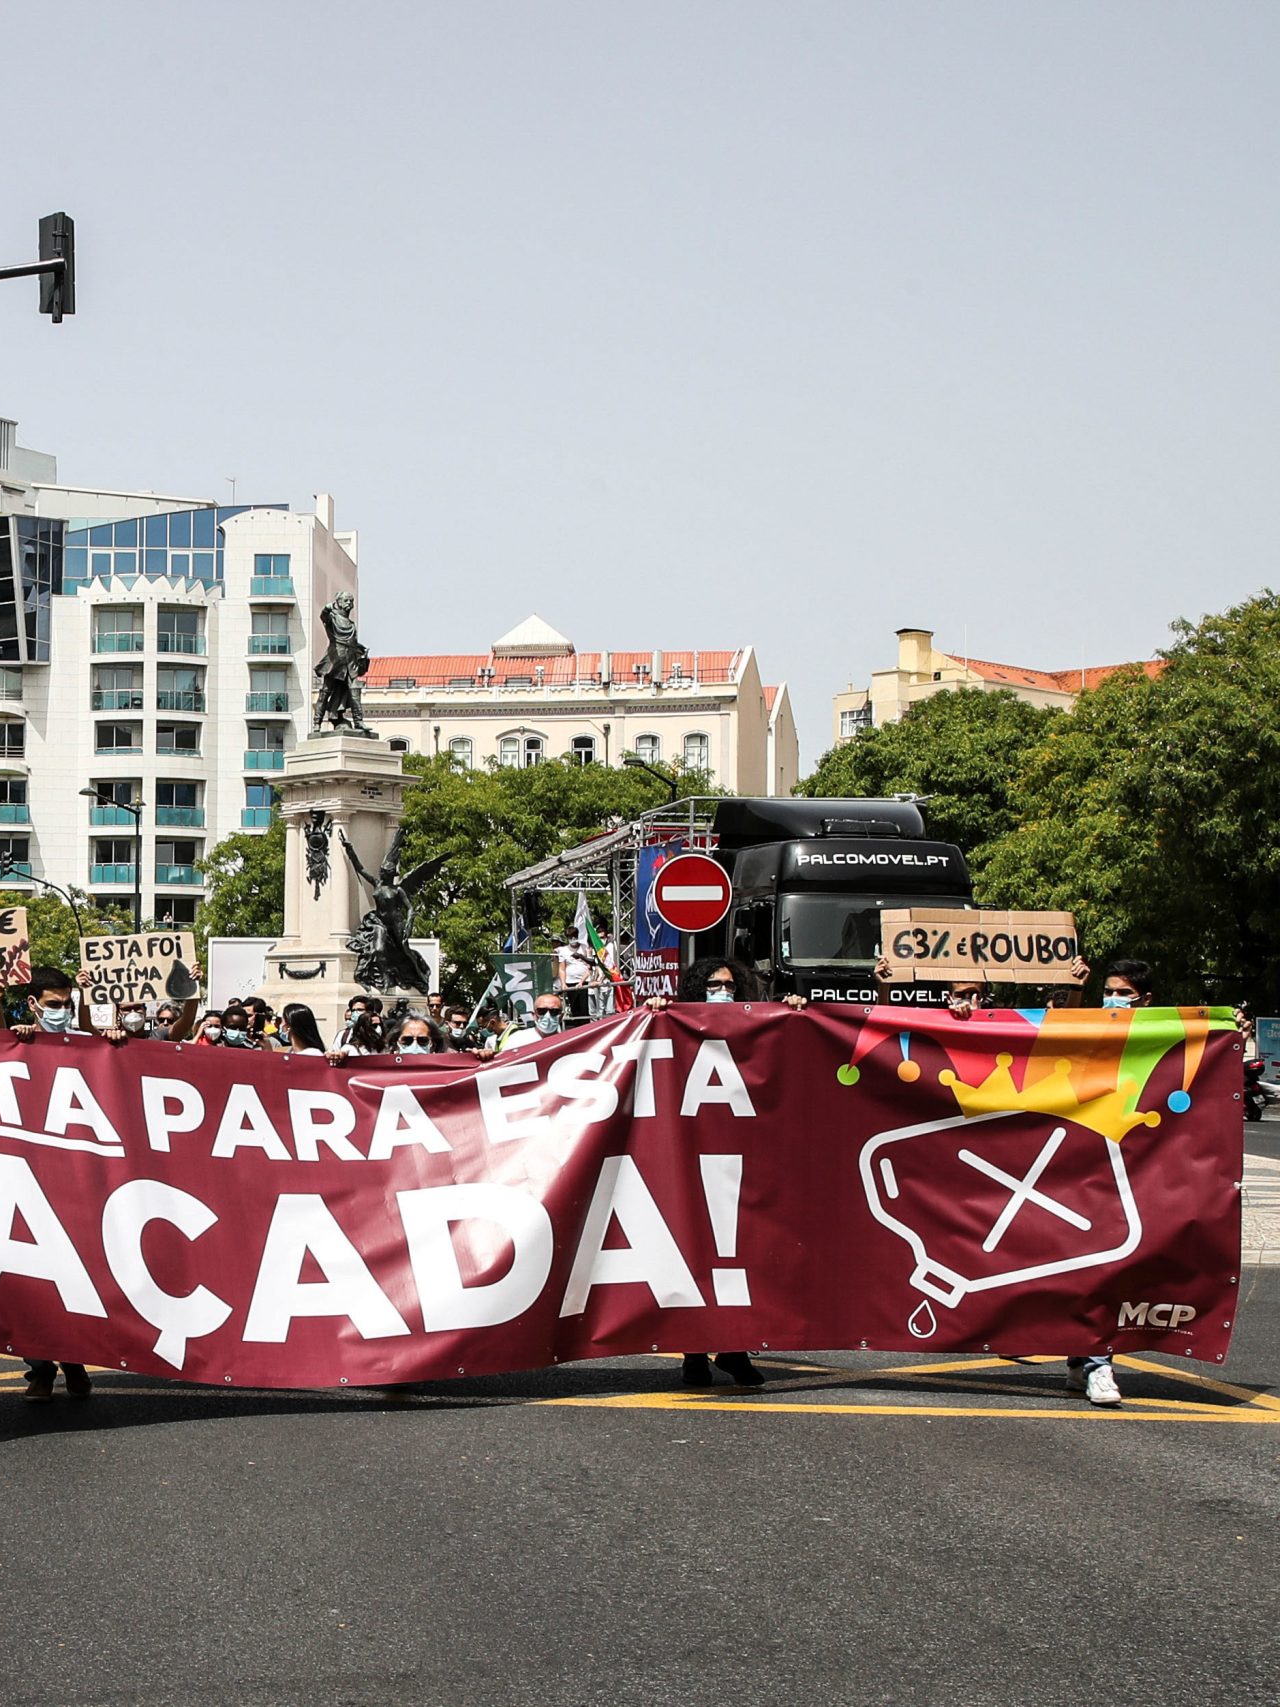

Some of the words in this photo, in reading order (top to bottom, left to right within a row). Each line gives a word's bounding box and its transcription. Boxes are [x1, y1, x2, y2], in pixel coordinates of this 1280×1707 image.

[797, 853, 950, 868] PALCOMOVEL.PT
[85, 938, 143, 961] ESTA
[892, 927, 950, 960] 63%
[91, 981, 158, 1005] GOTA
[140, 1076, 453, 1161] PARA
[475, 1038, 757, 1145] ESTA
[1117, 1301, 1197, 1328] MCP
